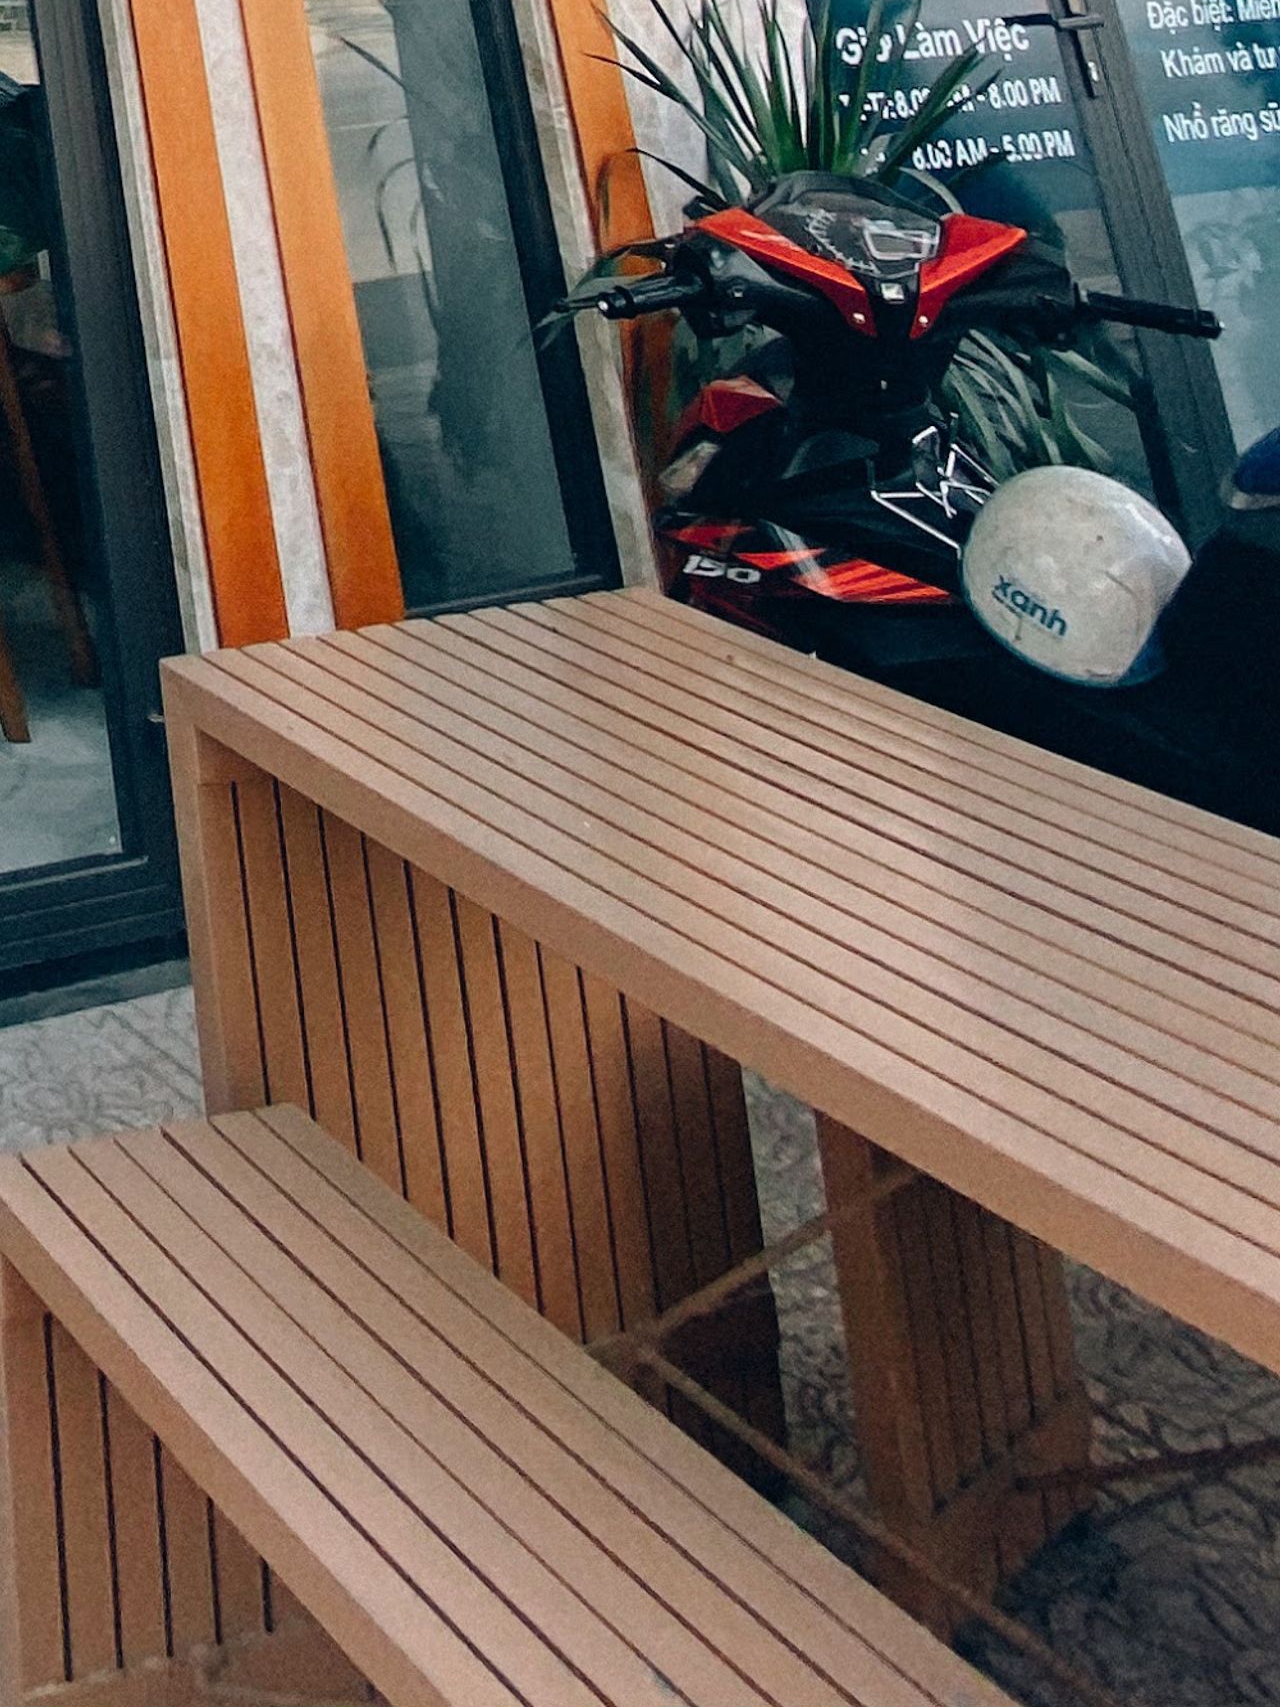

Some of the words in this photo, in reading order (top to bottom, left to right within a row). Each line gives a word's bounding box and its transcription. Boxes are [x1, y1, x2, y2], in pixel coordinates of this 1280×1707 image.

[1146, 0, 1189, 35] Đặc
[963, 16, 1030, 62] Việc
[1225, 41, 1254, 72] và
[989, 80, 1028, 109] 8.00
[1029, 76, 1062, 104] PM
[1210, 108, 1259, 141] răng
[955, 137, 989, 167] AM
[1002, 134, 1043, 162] 5.00
[1042, 129, 1076, 158] PM
[992, 574, 1069, 638] xanh
